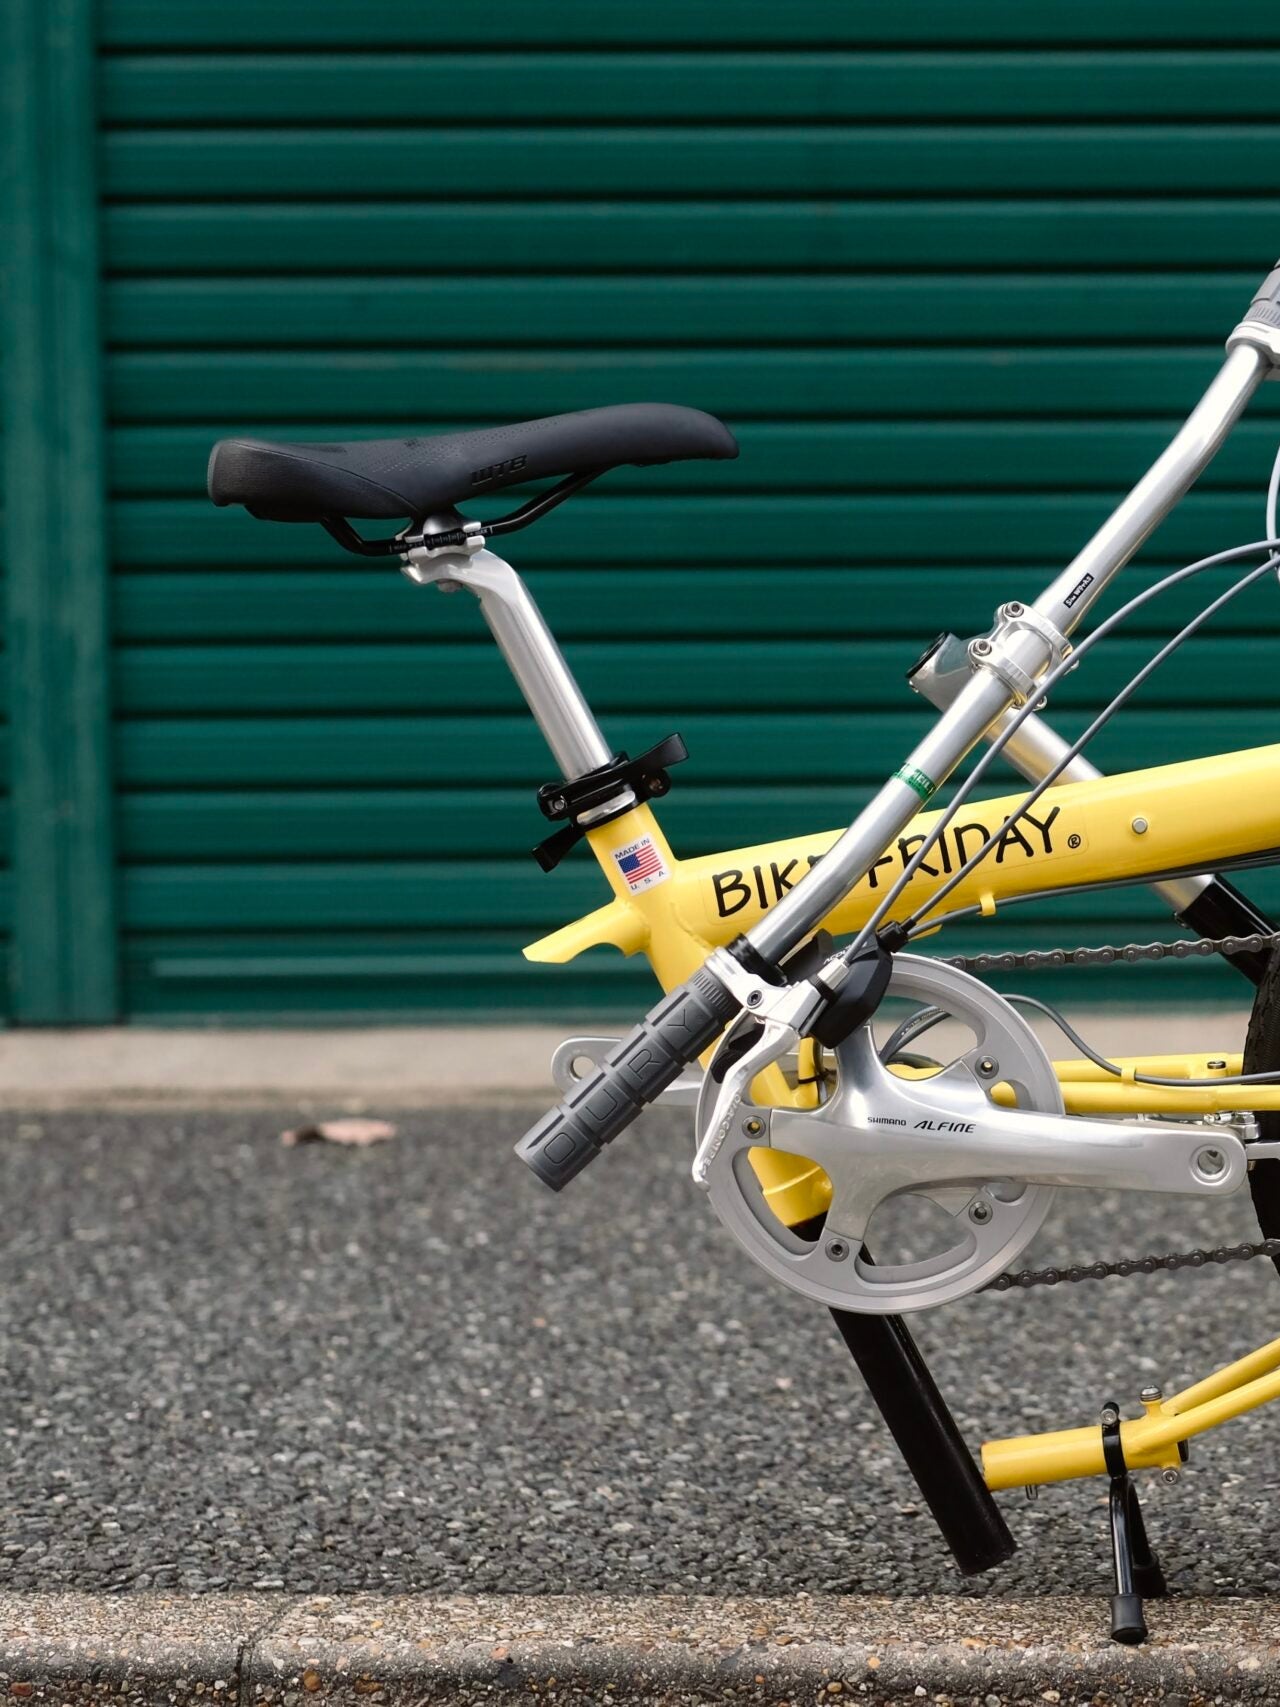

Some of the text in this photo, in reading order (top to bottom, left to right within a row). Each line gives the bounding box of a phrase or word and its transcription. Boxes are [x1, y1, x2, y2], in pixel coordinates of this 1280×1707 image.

[470, 454, 528, 486] WTB
[614, 837, 650, 860] MADE IN
[543, 1007, 692, 1165] OURY
[867, 1116, 977, 1134] SHIMANO ALFINE
